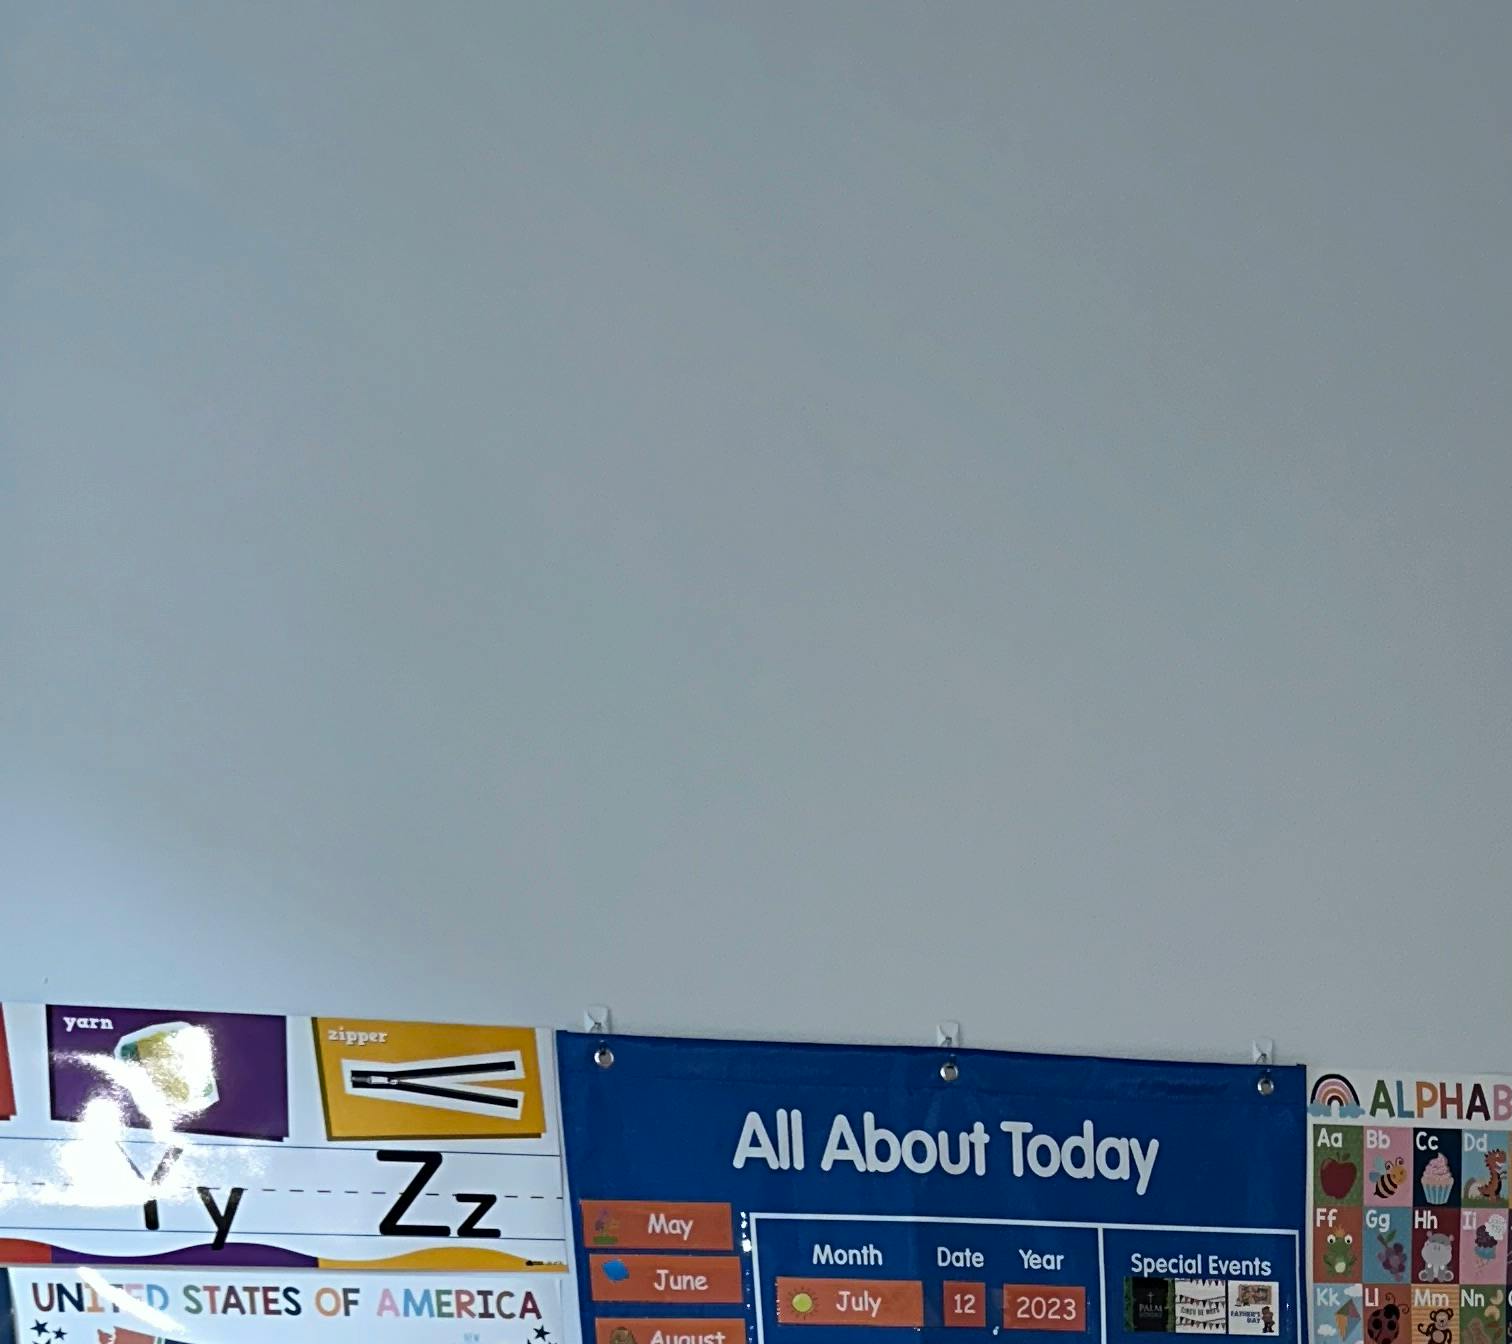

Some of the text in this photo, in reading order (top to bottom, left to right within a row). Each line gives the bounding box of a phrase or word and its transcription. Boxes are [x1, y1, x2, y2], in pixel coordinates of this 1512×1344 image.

[62, 1013, 114, 1031] yarn
[327, 1027, 388, 1045] zipper
[1317, 1128, 1343, 1148] Aa
[1416, 1131, 1439, 1151] Cc
[732, 1108, 1160, 1195] All About Today
[376, 1150, 501, 1238] Zz
[648, 1214, 694, 1241] May
[812, 1244, 882, 1266] Month
[937, 1246, 985, 1268] Date
[1019, 1248, 1064, 1271] Year
[1131, 1252, 1271, 1278] Special Events
[654, 1269, 709, 1291] June
[31, 1282, 543, 1320] UNITED STATES OF AMERICA
[836, 1291, 881, 1318] July
[954, 1294, 975, 1314] 12
[1016, 1297, 1077, 1320] 2023
